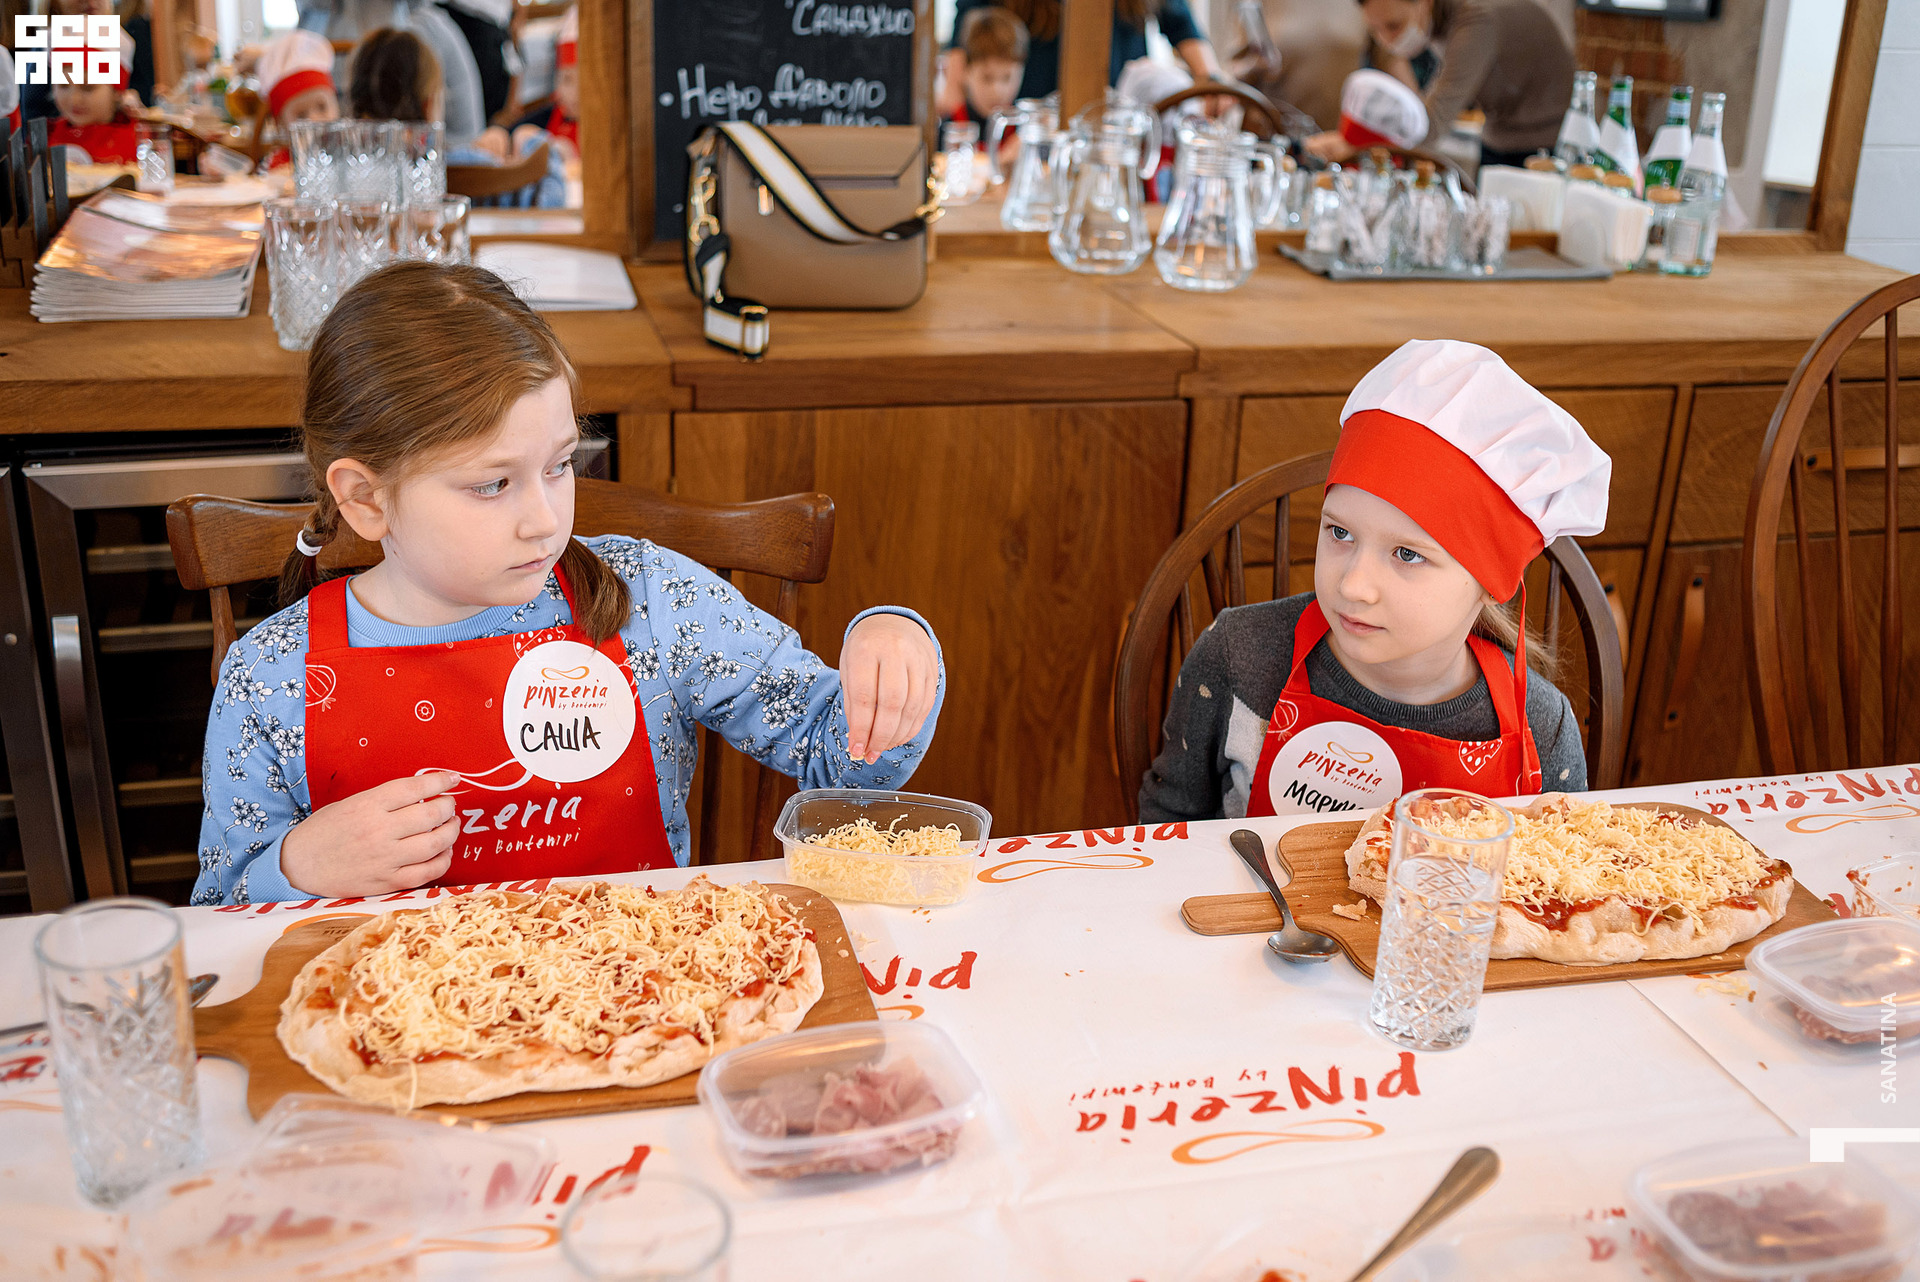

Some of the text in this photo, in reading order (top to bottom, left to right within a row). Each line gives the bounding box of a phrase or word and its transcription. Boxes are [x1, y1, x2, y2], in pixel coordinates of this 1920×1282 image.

[523, 679, 609, 709] piNzeria
[520, 715, 602, 753] САША
[1297, 750, 1383, 787] piNzeria
[462, 782, 582, 834] zeria
[463, 827, 581, 861] by Bontempi
[1075, 1051, 1421, 1144] piNzeria
